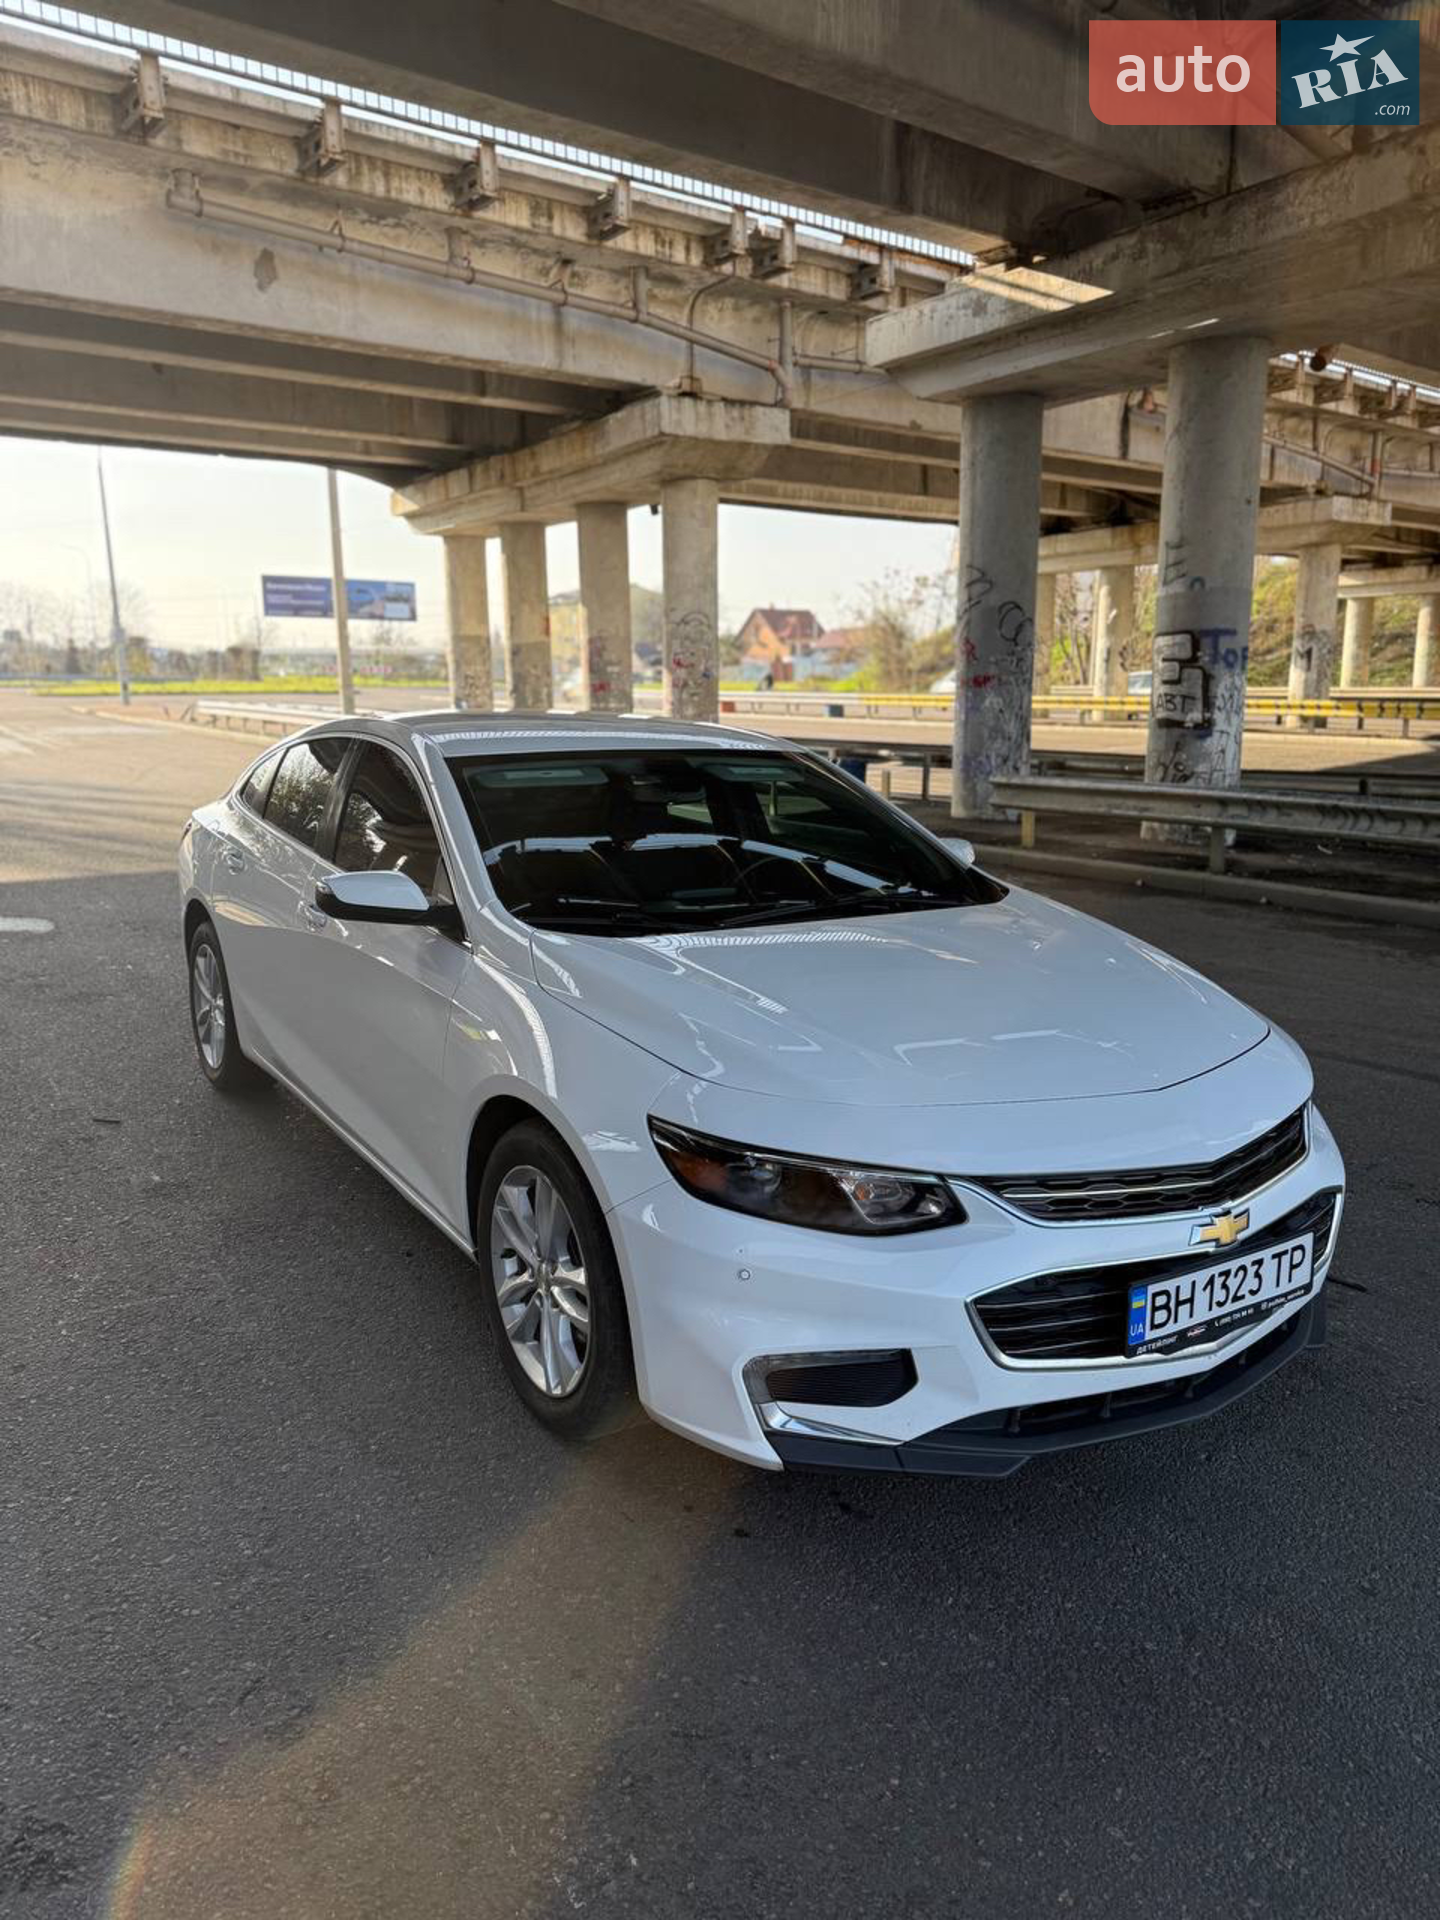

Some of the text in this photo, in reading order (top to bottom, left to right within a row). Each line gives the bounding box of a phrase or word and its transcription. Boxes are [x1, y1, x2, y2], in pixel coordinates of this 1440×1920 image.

[1150, 1279, 1196, 1331] BH
[1202, 1257, 1264, 1312] 1323
[1271, 1244, 1306, 1288] TP
[1130, 1324, 1144, 1336] UA
